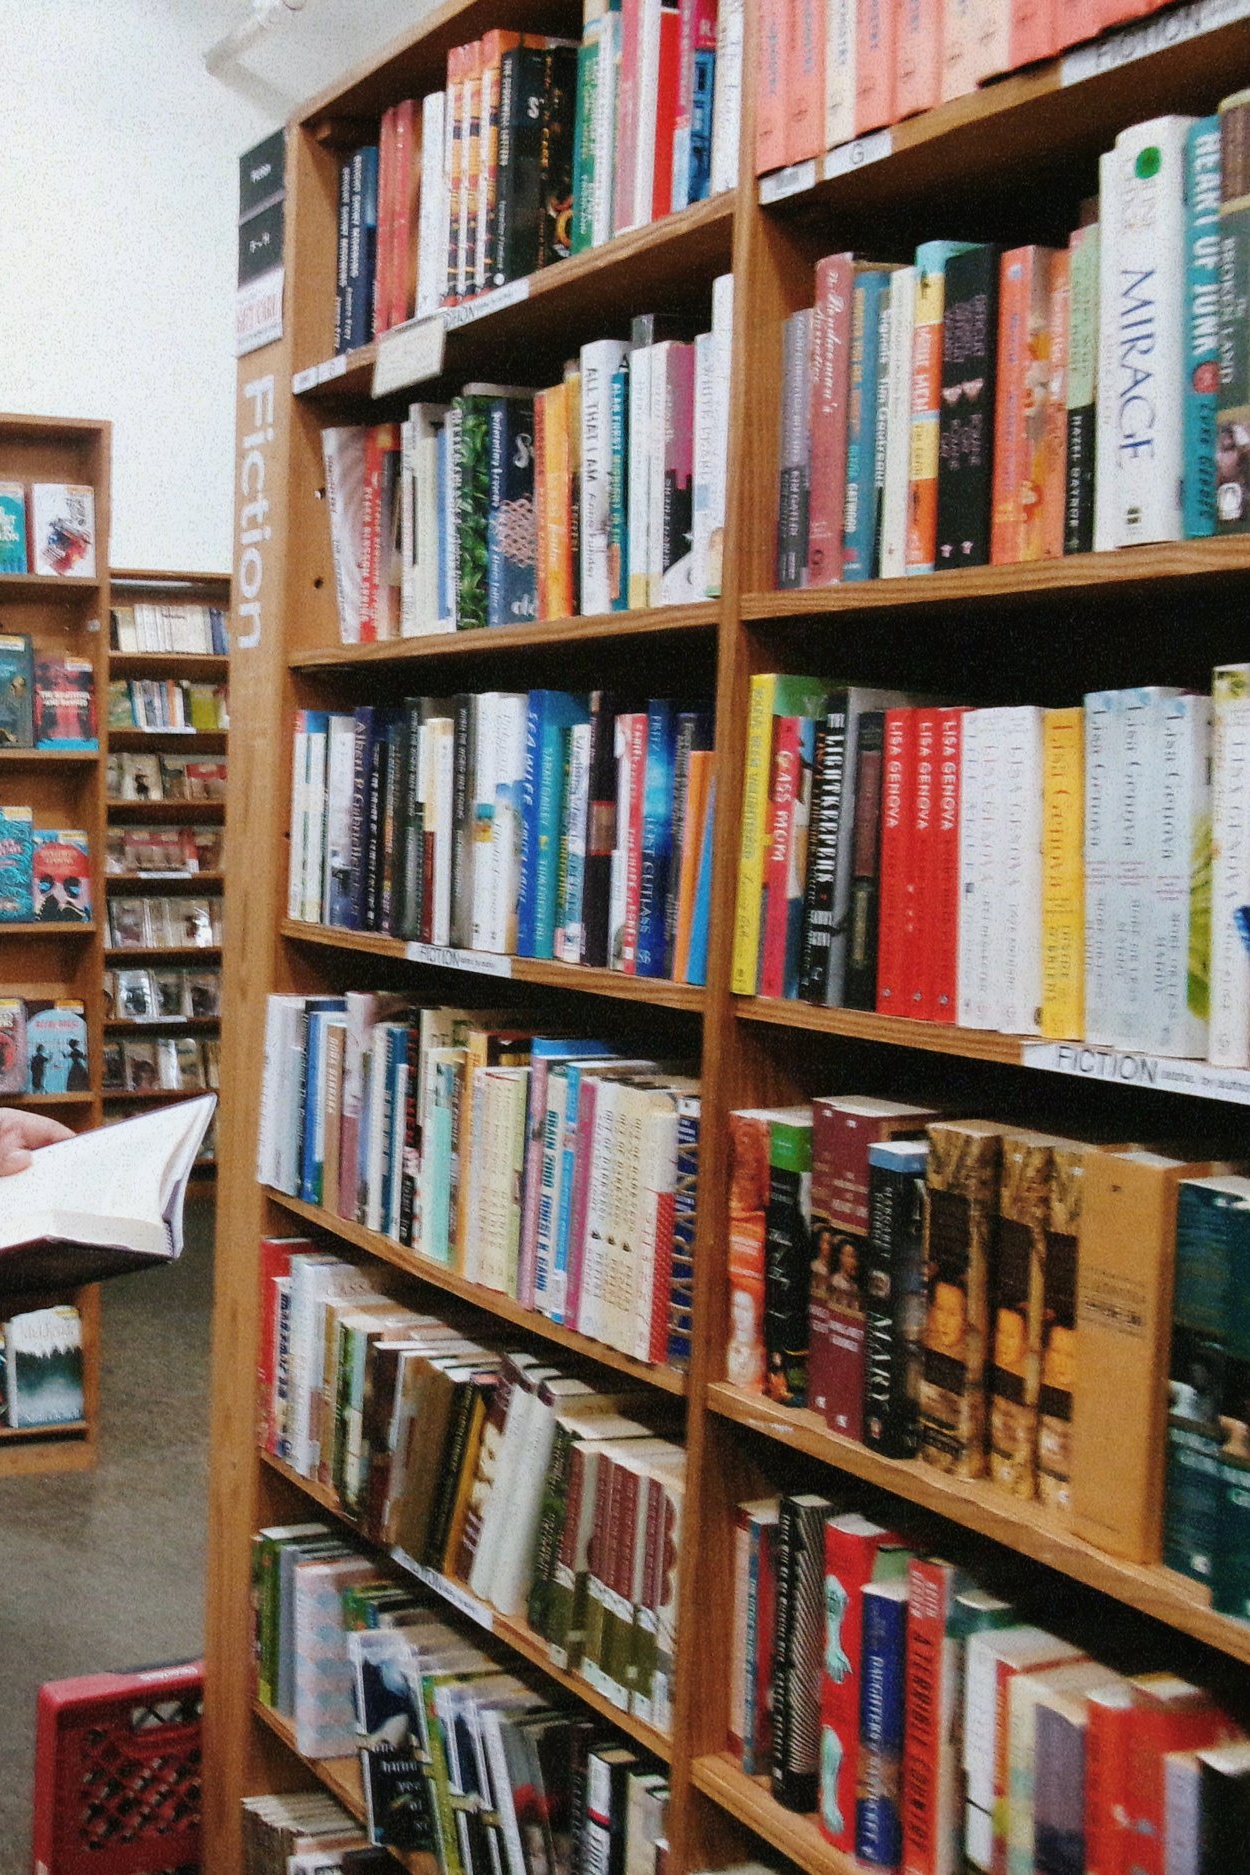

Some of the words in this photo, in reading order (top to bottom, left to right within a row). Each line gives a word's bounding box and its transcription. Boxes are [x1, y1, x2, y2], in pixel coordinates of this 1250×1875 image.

[1190, 284, 1221, 357] JUNK
[1119, 268, 1157, 467] MIRAGE
[585, 402, 599, 441] THAT
[1069, 415, 1083, 460] HAZEL
[584, 458, 599, 484] AM
[237, 373, 276, 650] Fiction
[888, 720, 904, 756] LISA
[918, 721, 933, 757] LISA
[941, 720, 957, 757] LISA
[1051, 723, 1075, 778] Lisa
[1090, 709, 1109, 753] Lisa
[1124, 704, 1145, 752] Lisa
[1161, 712, 1183, 763] Lisa
[815, 734, 845, 883] LIGHTKEEPERS
[886, 760, 903, 829] GENOVA
[915, 761, 932, 831] GENOVA
[939, 761, 956, 832] GENOVA
[1088, 762, 1108, 849] Genova
[1122, 761, 1144, 848] Genova
[1159, 771, 1182, 859] Genova
[771, 810, 791, 863] MOM
[1049, 787, 1075, 889] Genova
[1057, 1045, 1160, 1084] FICTION
[543, 1109, 560, 1151] BRAIN
[536, 1192, 554, 1240] ERNEST
[533, 1255, 550, 1293] GANN
[868, 1310, 893, 1403] MARY
[868, 1654, 885, 1740] DAUGHTERS
[911, 1650, 932, 1747] TERRIBLE
[912, 1755, 933, 1853] COUNTRY
